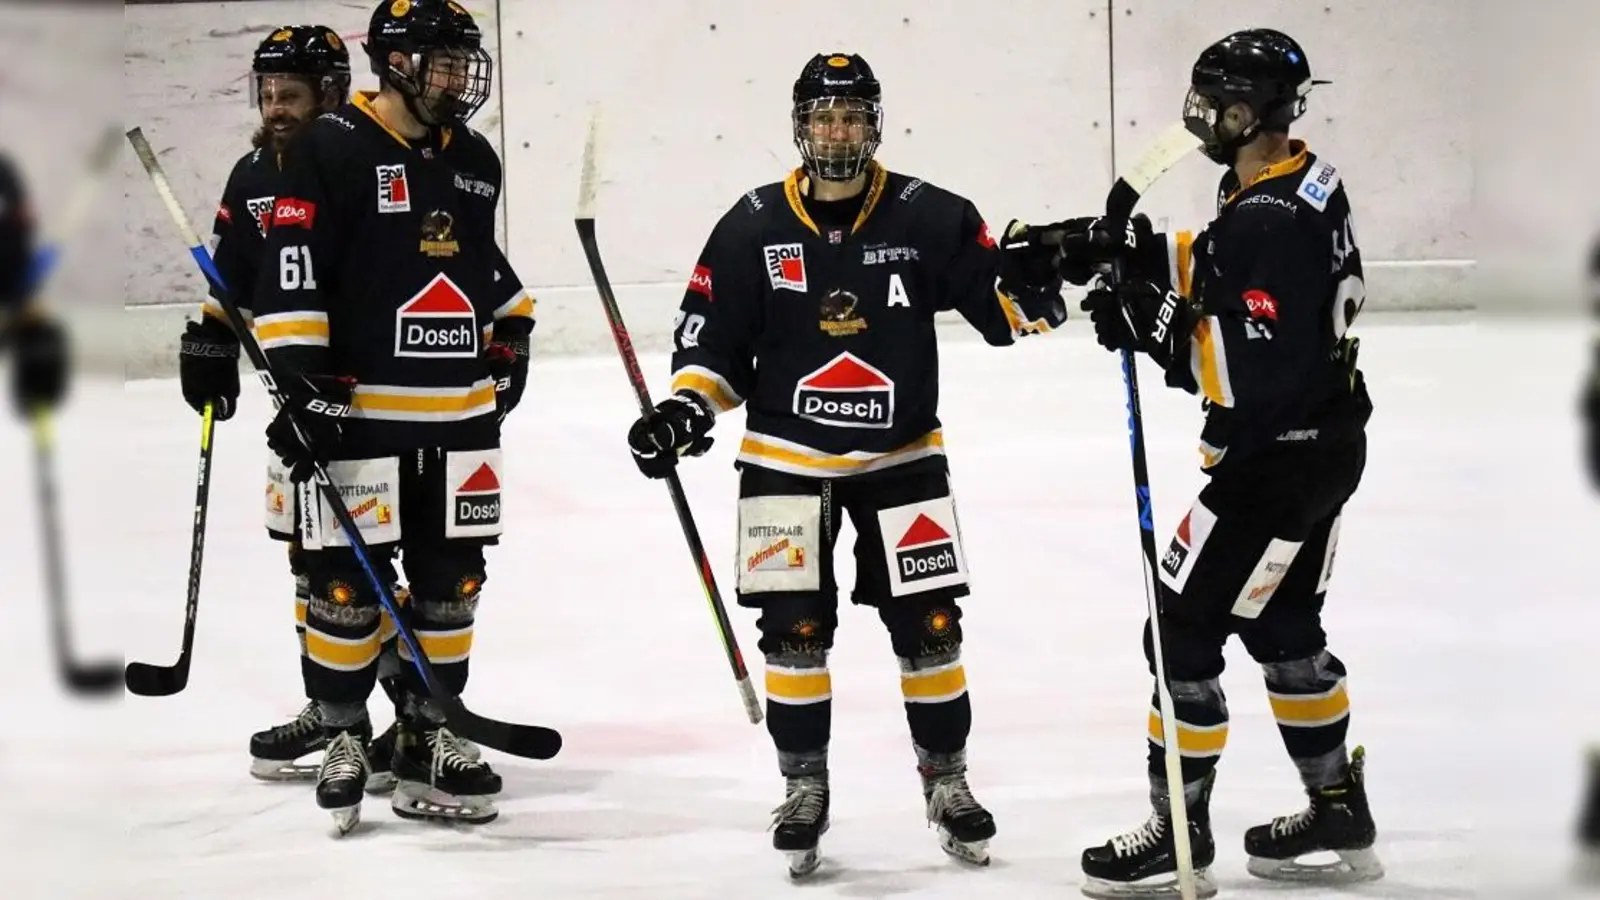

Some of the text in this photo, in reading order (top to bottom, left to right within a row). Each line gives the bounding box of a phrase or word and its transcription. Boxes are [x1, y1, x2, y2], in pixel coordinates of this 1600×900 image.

[280, 245, 317, 290] 61
[887, 273, 911, 307] A
[406, 325, 471, 346] Dosch
[805, 396, 883, 419] Dosch
[338, 482, 389, 498] OTTERMAIR
[902, 550, 955, 576] Dosch
